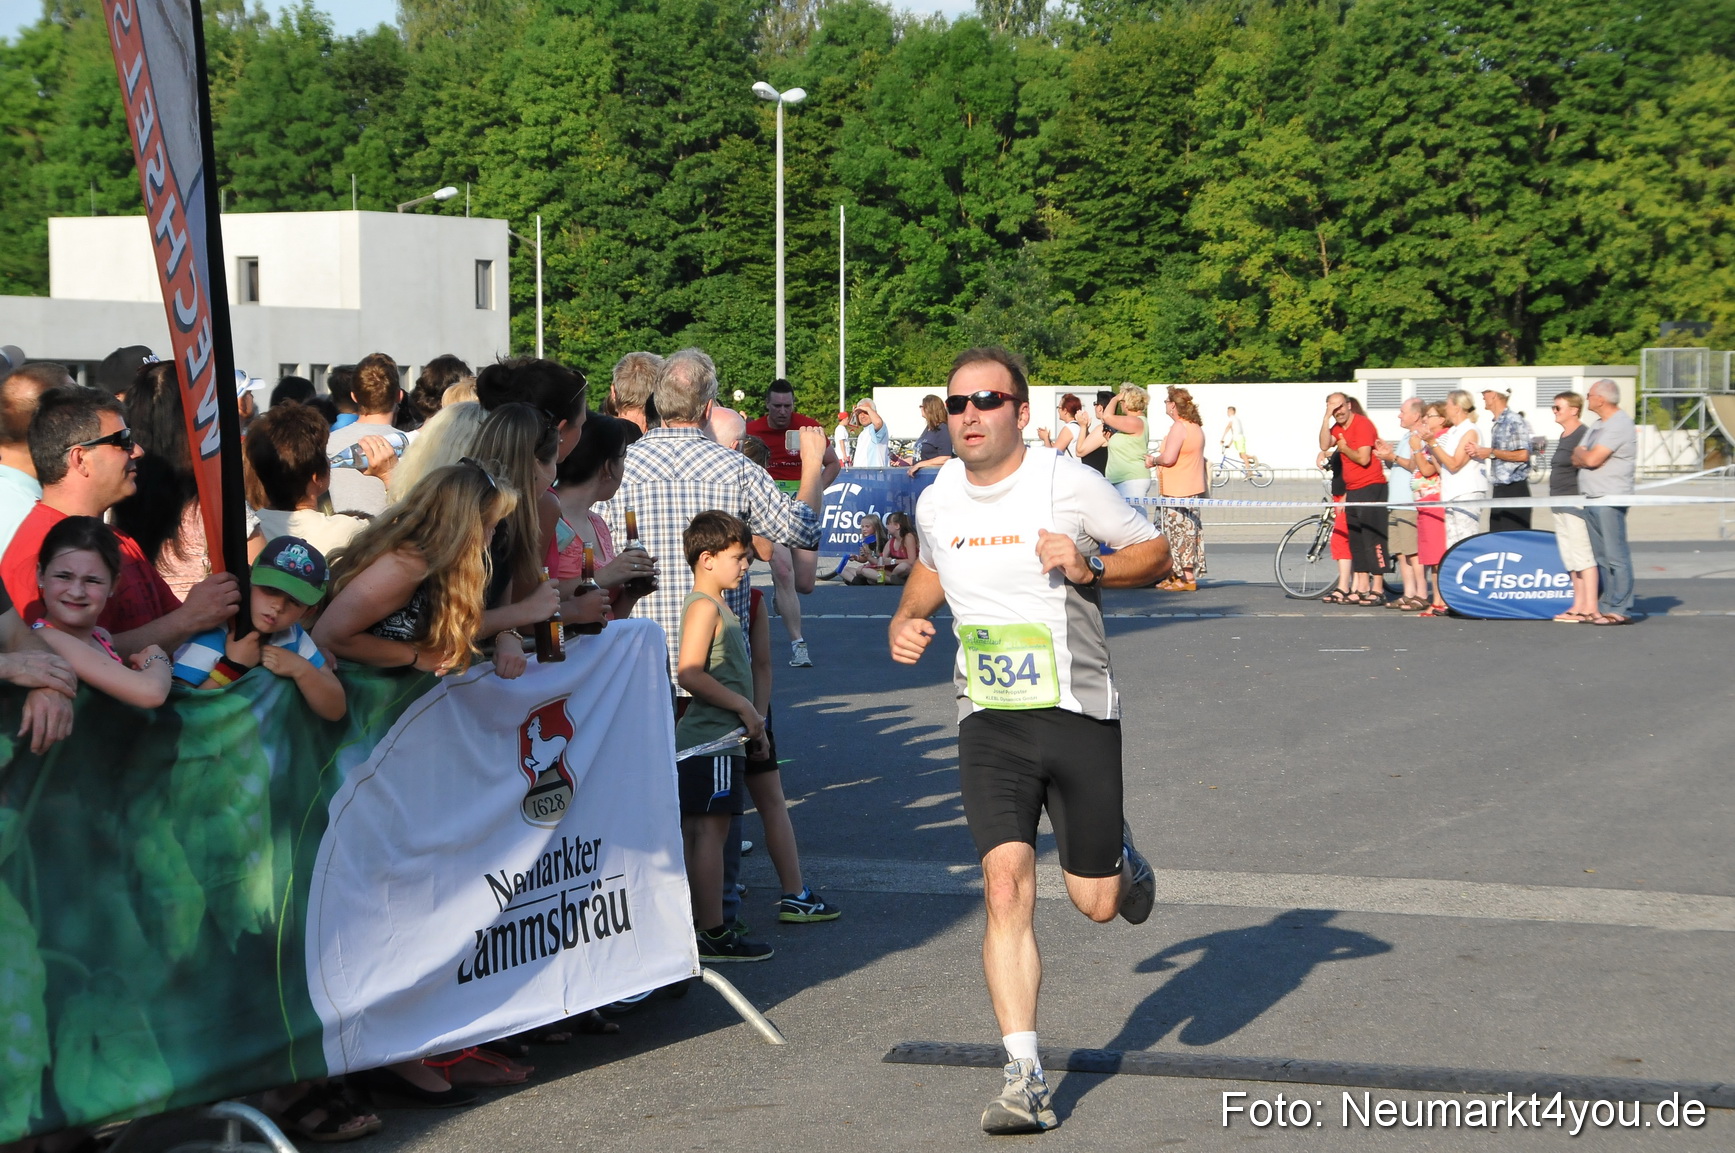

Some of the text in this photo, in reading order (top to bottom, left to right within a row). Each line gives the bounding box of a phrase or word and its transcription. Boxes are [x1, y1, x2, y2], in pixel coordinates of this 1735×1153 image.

[968, 535, 1025, 547] KLEBL
[1478, 569, 1574, 589] Fische
[978, 653, 1040, 688] 534
[532, 794, 566, 818] 1628
